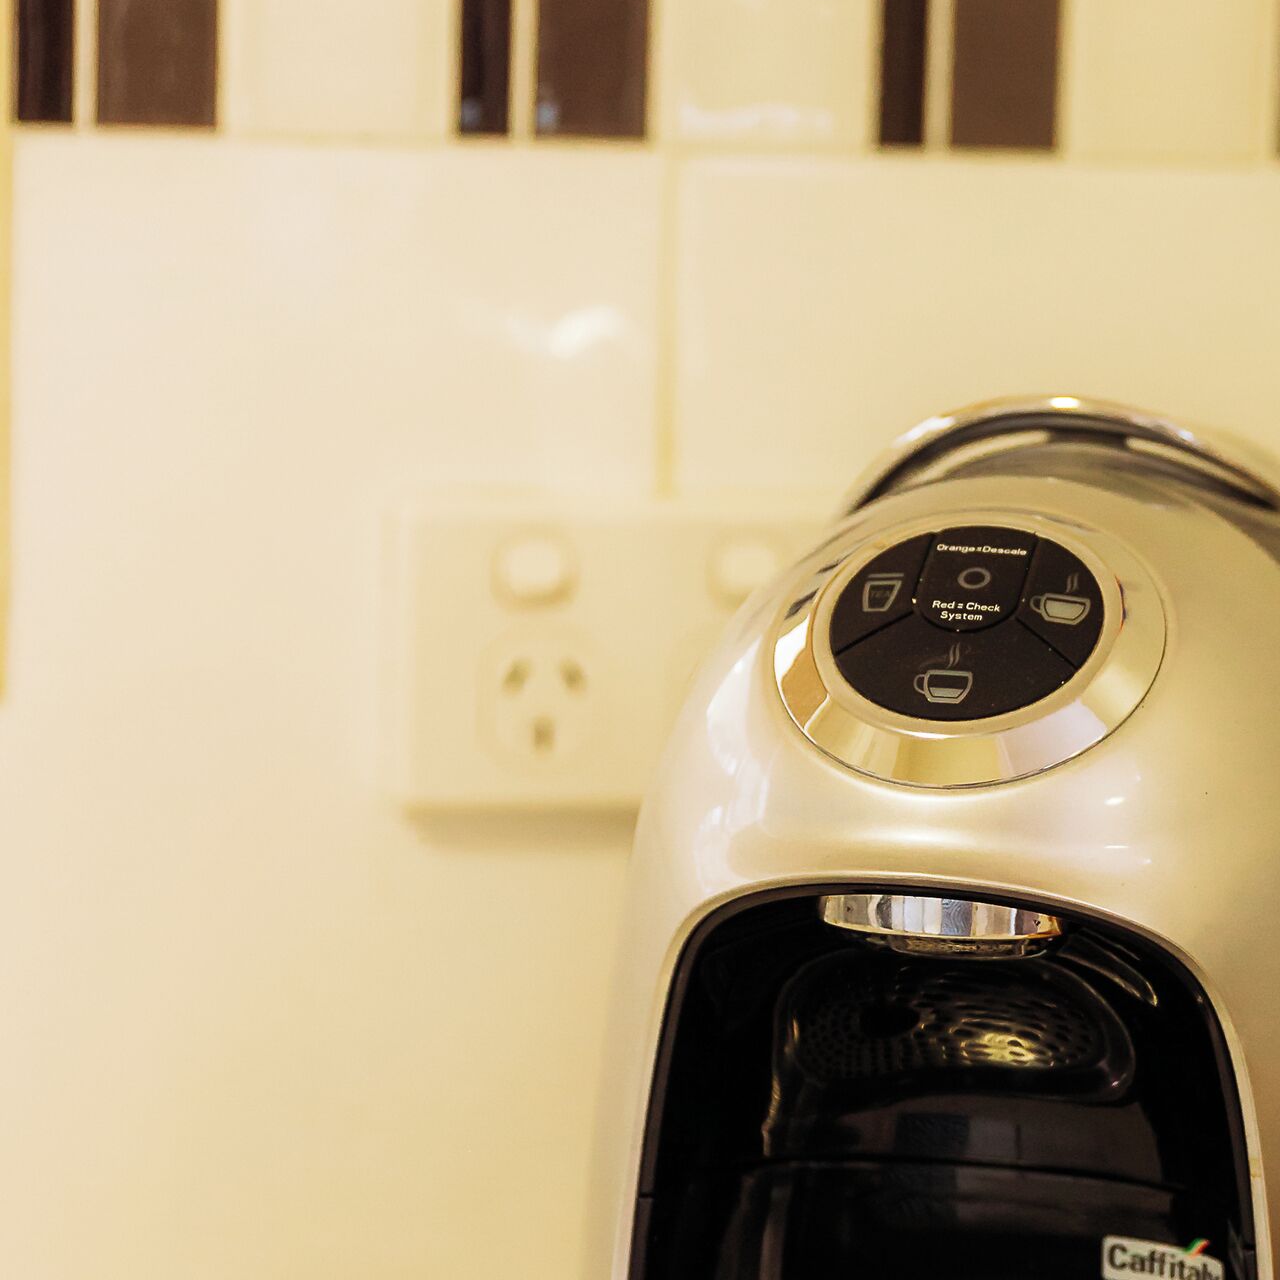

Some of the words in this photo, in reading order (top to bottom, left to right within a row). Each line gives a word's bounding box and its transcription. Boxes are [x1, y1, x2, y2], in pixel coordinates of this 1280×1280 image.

[932, 600, 956, 610] Red
[965, 602, 1001, 613] Check
[940, 610, 983, 621] System
